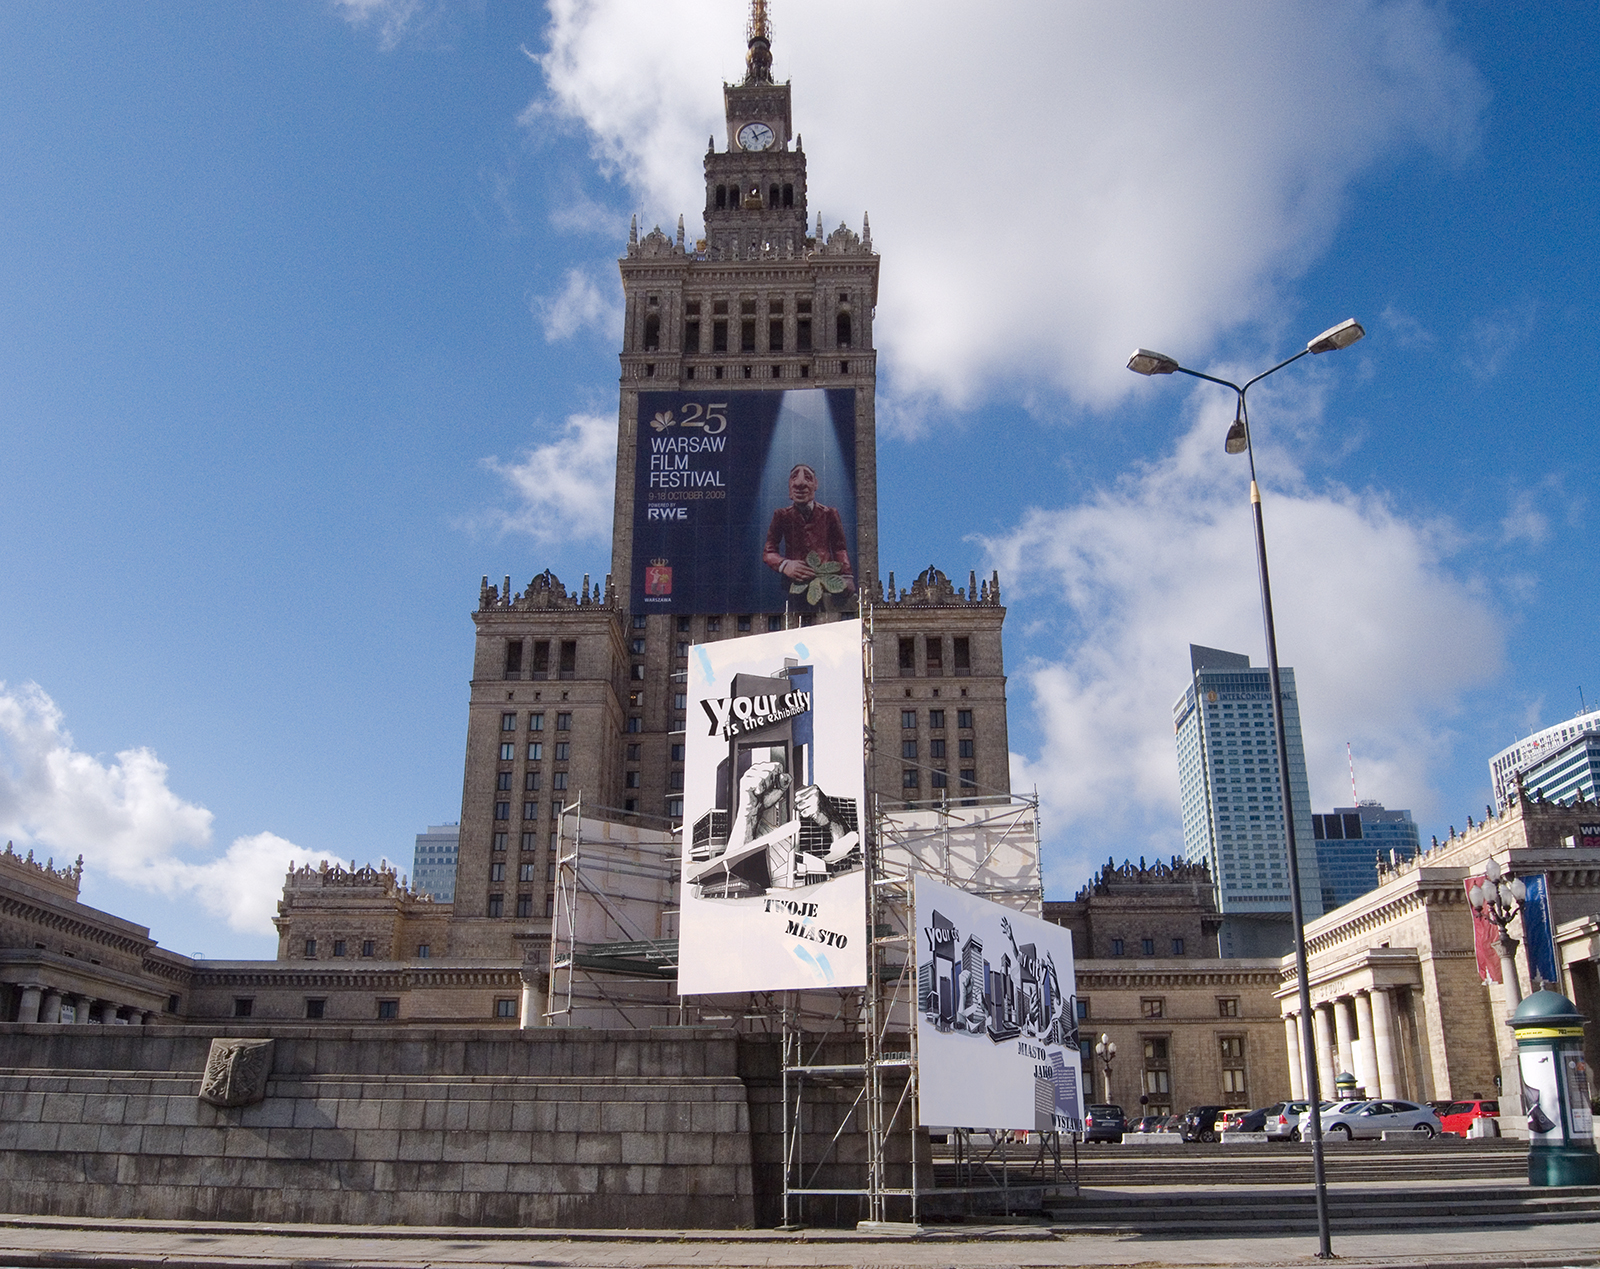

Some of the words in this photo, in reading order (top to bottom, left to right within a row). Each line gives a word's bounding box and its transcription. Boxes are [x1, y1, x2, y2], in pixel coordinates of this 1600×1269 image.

[681, 403, 727, 434] 25
[650, 436, 727, 453] WARSAW
[650, 454, 689, 470] FILM
[650, 471, 726, 488] FESTIVAL
[648, 491, 666, 501] 9-18
[667, 491, 704, 500] OCTOBER
[705, 490, 726, 499] 2009
[648, 508, 688, 520] RWE
[782, 688, 811, 712] city
[724, 714, 740, 741] is
[743, 715, 765, 730] the
[767, 705, 805, 723] exhibition
[763, 899, 819, 918] TWOJE
[785, 919, 848, 950] MIASTO
[1017, 1042, 1046, 1061] MIASTO
[1033, 1065, 1053, 1079] JAKO
